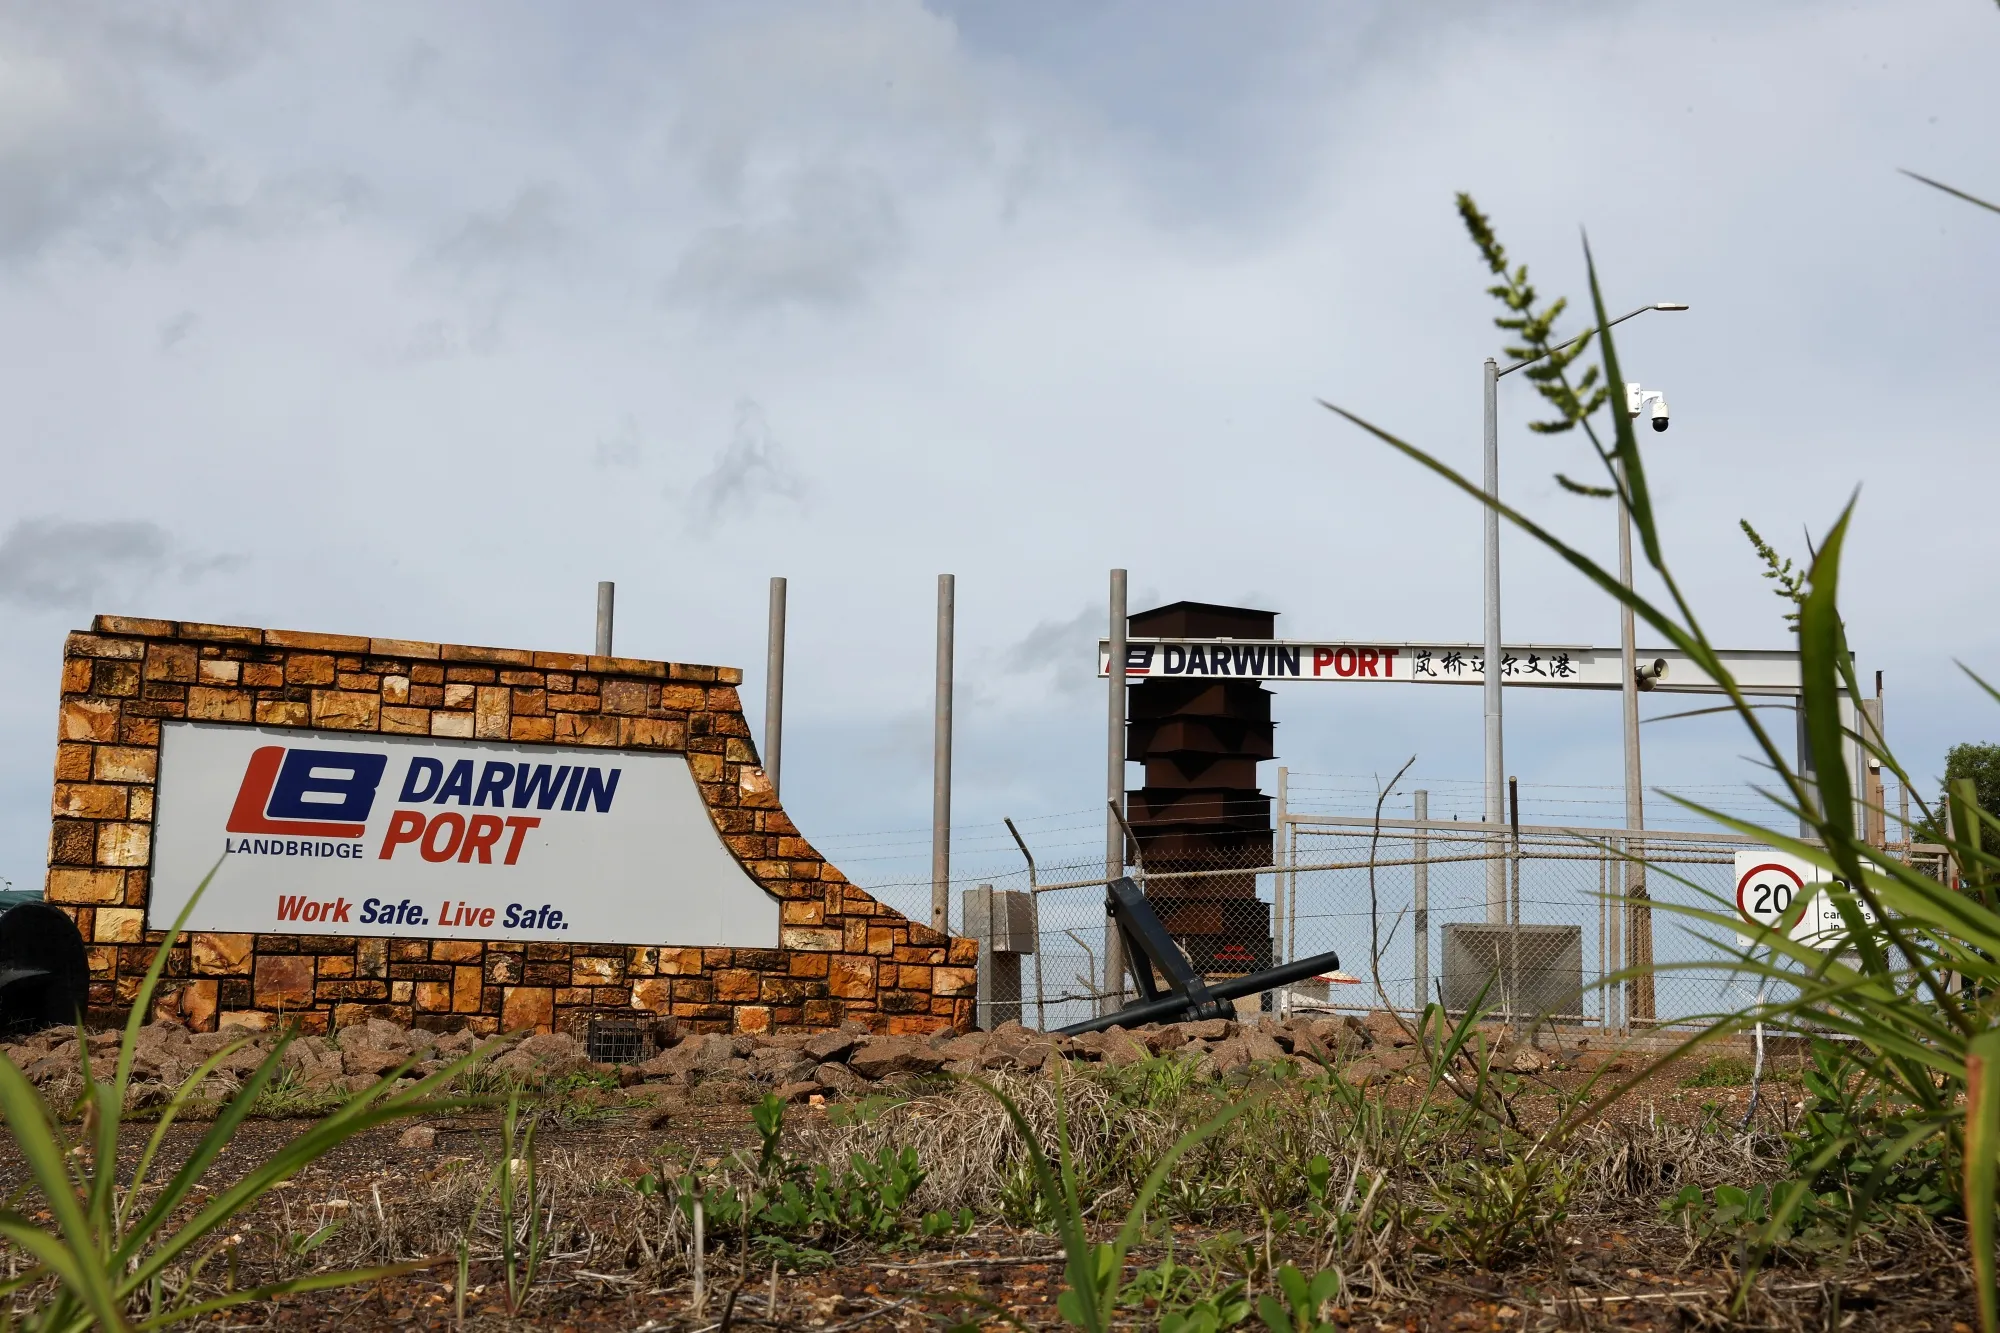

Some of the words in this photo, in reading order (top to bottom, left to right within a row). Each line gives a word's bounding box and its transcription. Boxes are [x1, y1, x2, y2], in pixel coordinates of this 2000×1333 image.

[1163, 644, 1301, 676] DARWIN
[1313, 647, 1399, 677] PORT
[398, 756, 622, 813] DARWIN
[225, 838, 364, 859] LANDBRIDGE
[378, 810, 542, 865] PORT
[277, 895, 353, 923] Work
[359, 898, 429, 926] Safe.
[438, 901, 496, 928] Live
[502, 903, 569, 930] Safe.
[1753, 883, 1792, 914] 20
